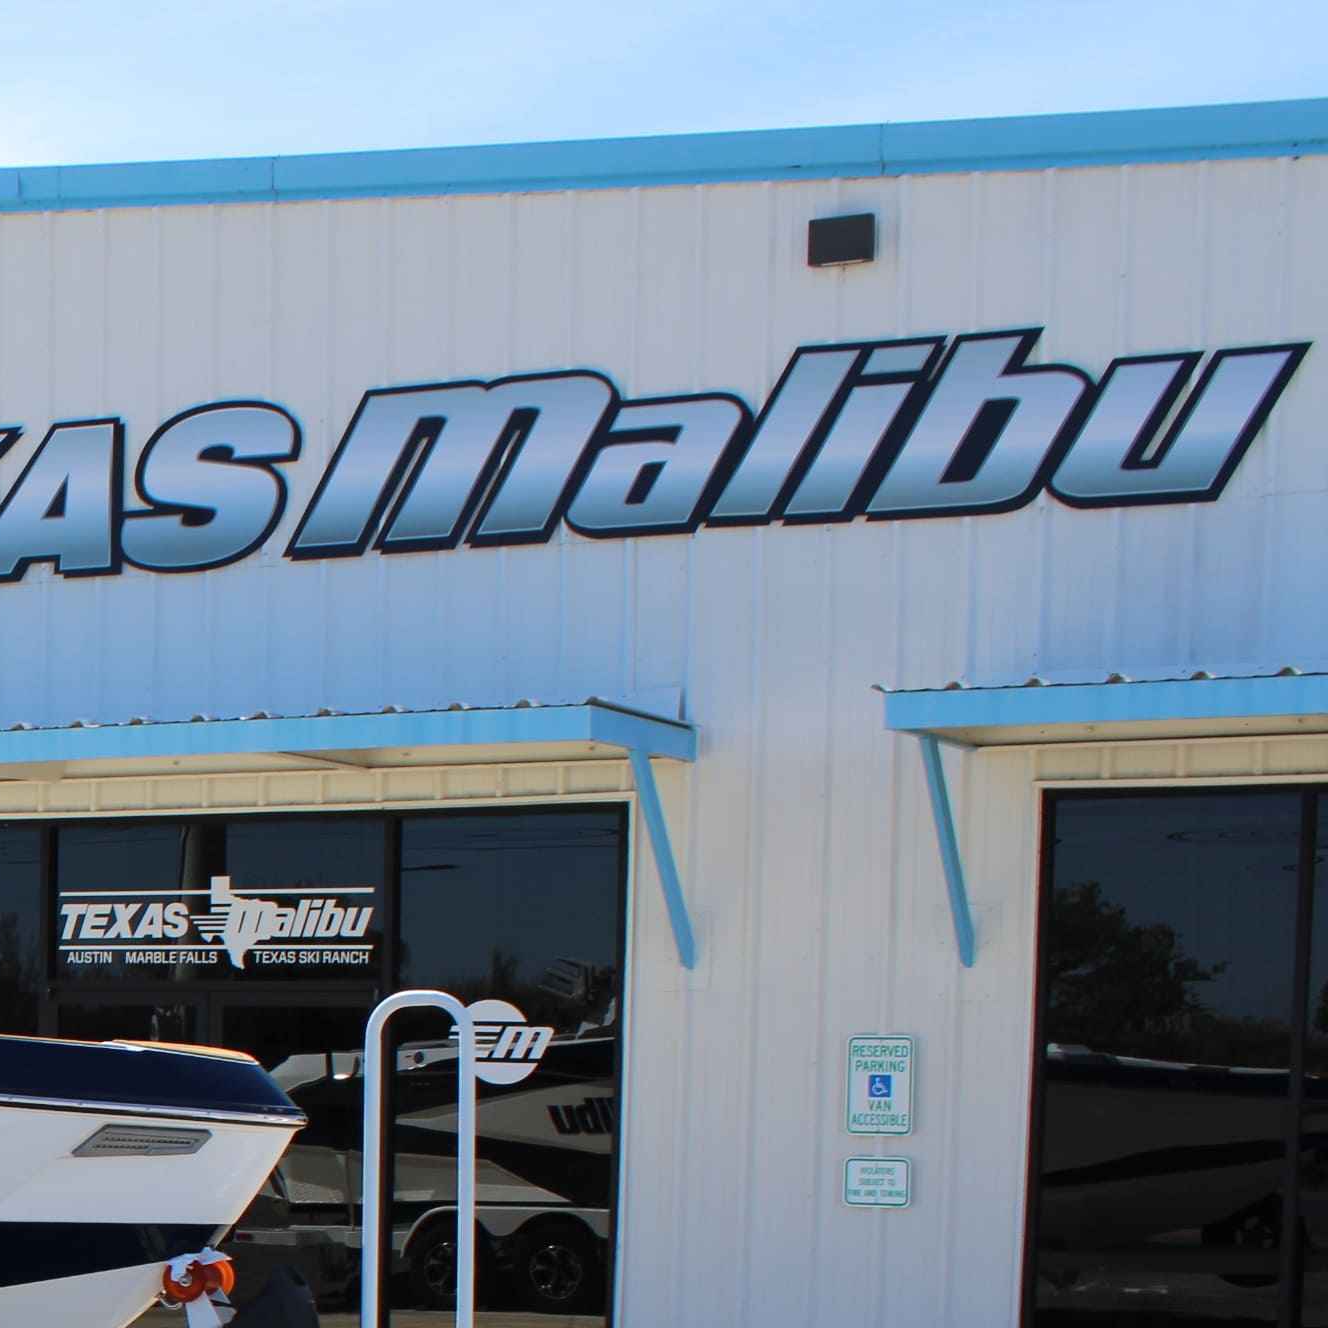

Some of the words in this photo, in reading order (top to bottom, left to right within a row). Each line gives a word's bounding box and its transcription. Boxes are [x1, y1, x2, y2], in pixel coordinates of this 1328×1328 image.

[287, 327, 1313, 560] Malibu
[59, 902, 189, 940] TEXAS
[67, 951, 112, 964] AUSTIN
[125, 951, 176, 964] MARBLE
[179, 951, 217, 964] FALLS
[254, 951, 295, 964] TEXAS
[298, 951, 320, 964] SKI
[322, 951, 369, 964] RANCH
[852, 1045, 908, 1058] RESERVED
[855, 1060, 905, 1073] PARKING
[869, 1100, 891, 1111] VAN
[851, 1113, 907, 1127] ACCESSIBLE
